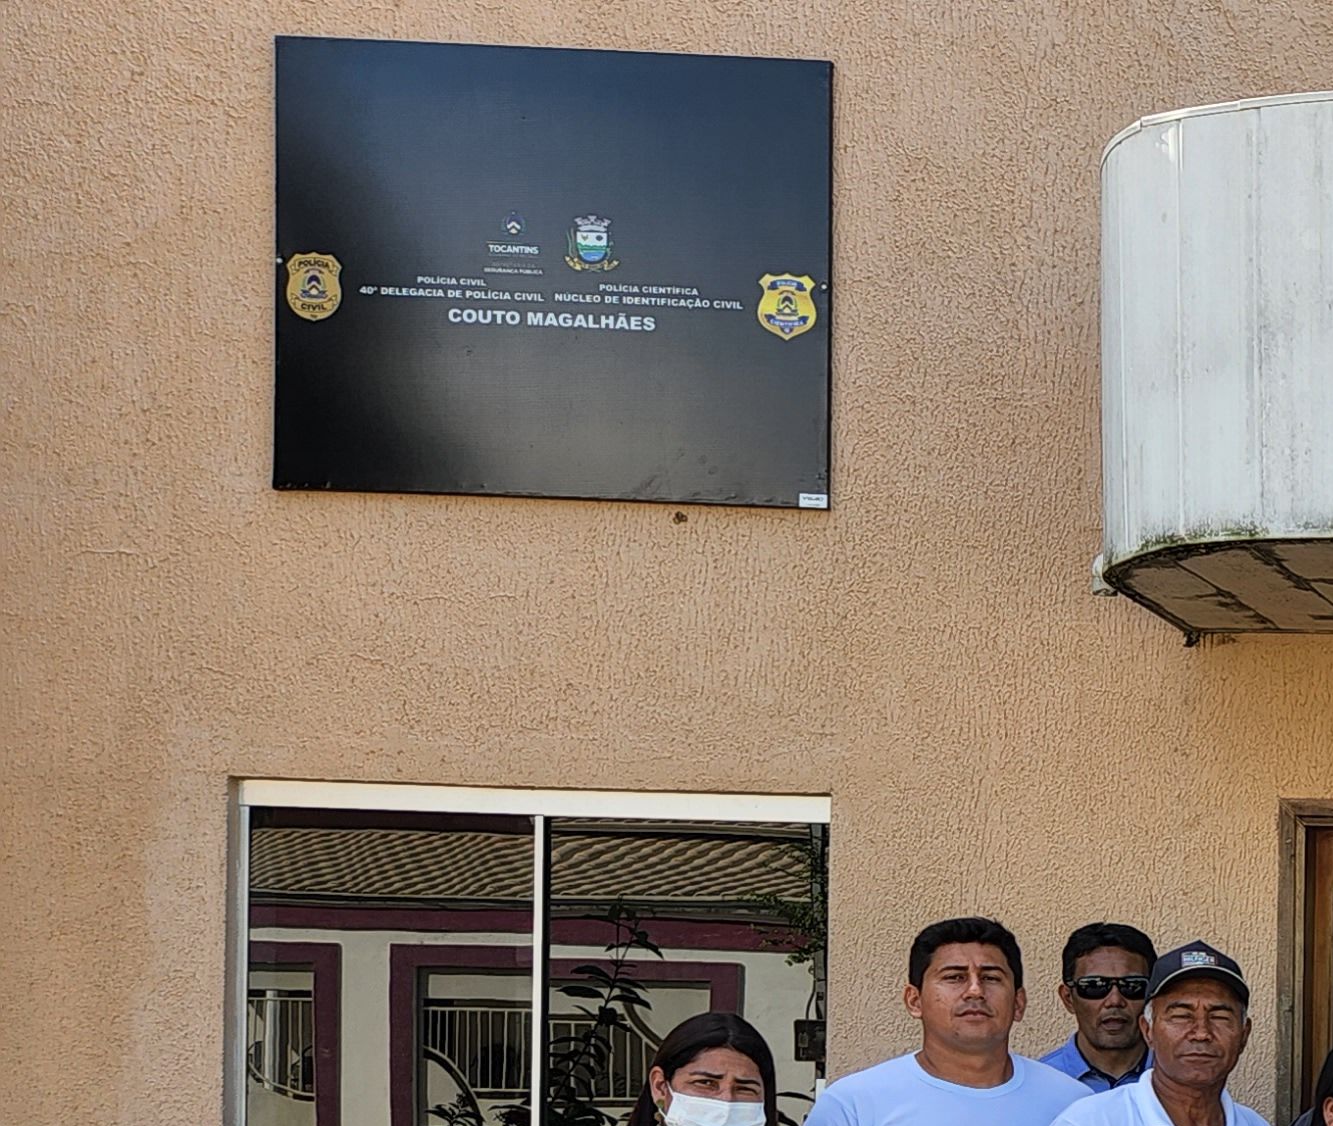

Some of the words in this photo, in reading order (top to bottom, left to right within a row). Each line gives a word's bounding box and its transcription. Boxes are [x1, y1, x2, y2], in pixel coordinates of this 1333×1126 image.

[488, 244, 539, 254] TOCANTINS
[417, 275, 458, 285] POLÍCIA
[459, 277, 487, 287] CIVIL
[380, 287, 445, 297] DELEGACIA
[447, 289, 463, 298] DE
[465, 289, 511, 300] POLÍCIA
[514, 292, 544, 302] CIVIL
[599, 284, 640, 293] POLÍCIA
[642, 286, 699, 296] CIENTÍFICA
[301, 303, 327, 311] CIVIL
[554, 292, 601, 303] NÚCLEO
[604, 296, 620, 304] DE
[622, 296, 710, 309] IDENTIFICAÇÃO
[713, 300, 744, 310] CIVIL
[448, 308, 520, 325] COUTO
[527, 311, 656, 331] MAGALHÃES
